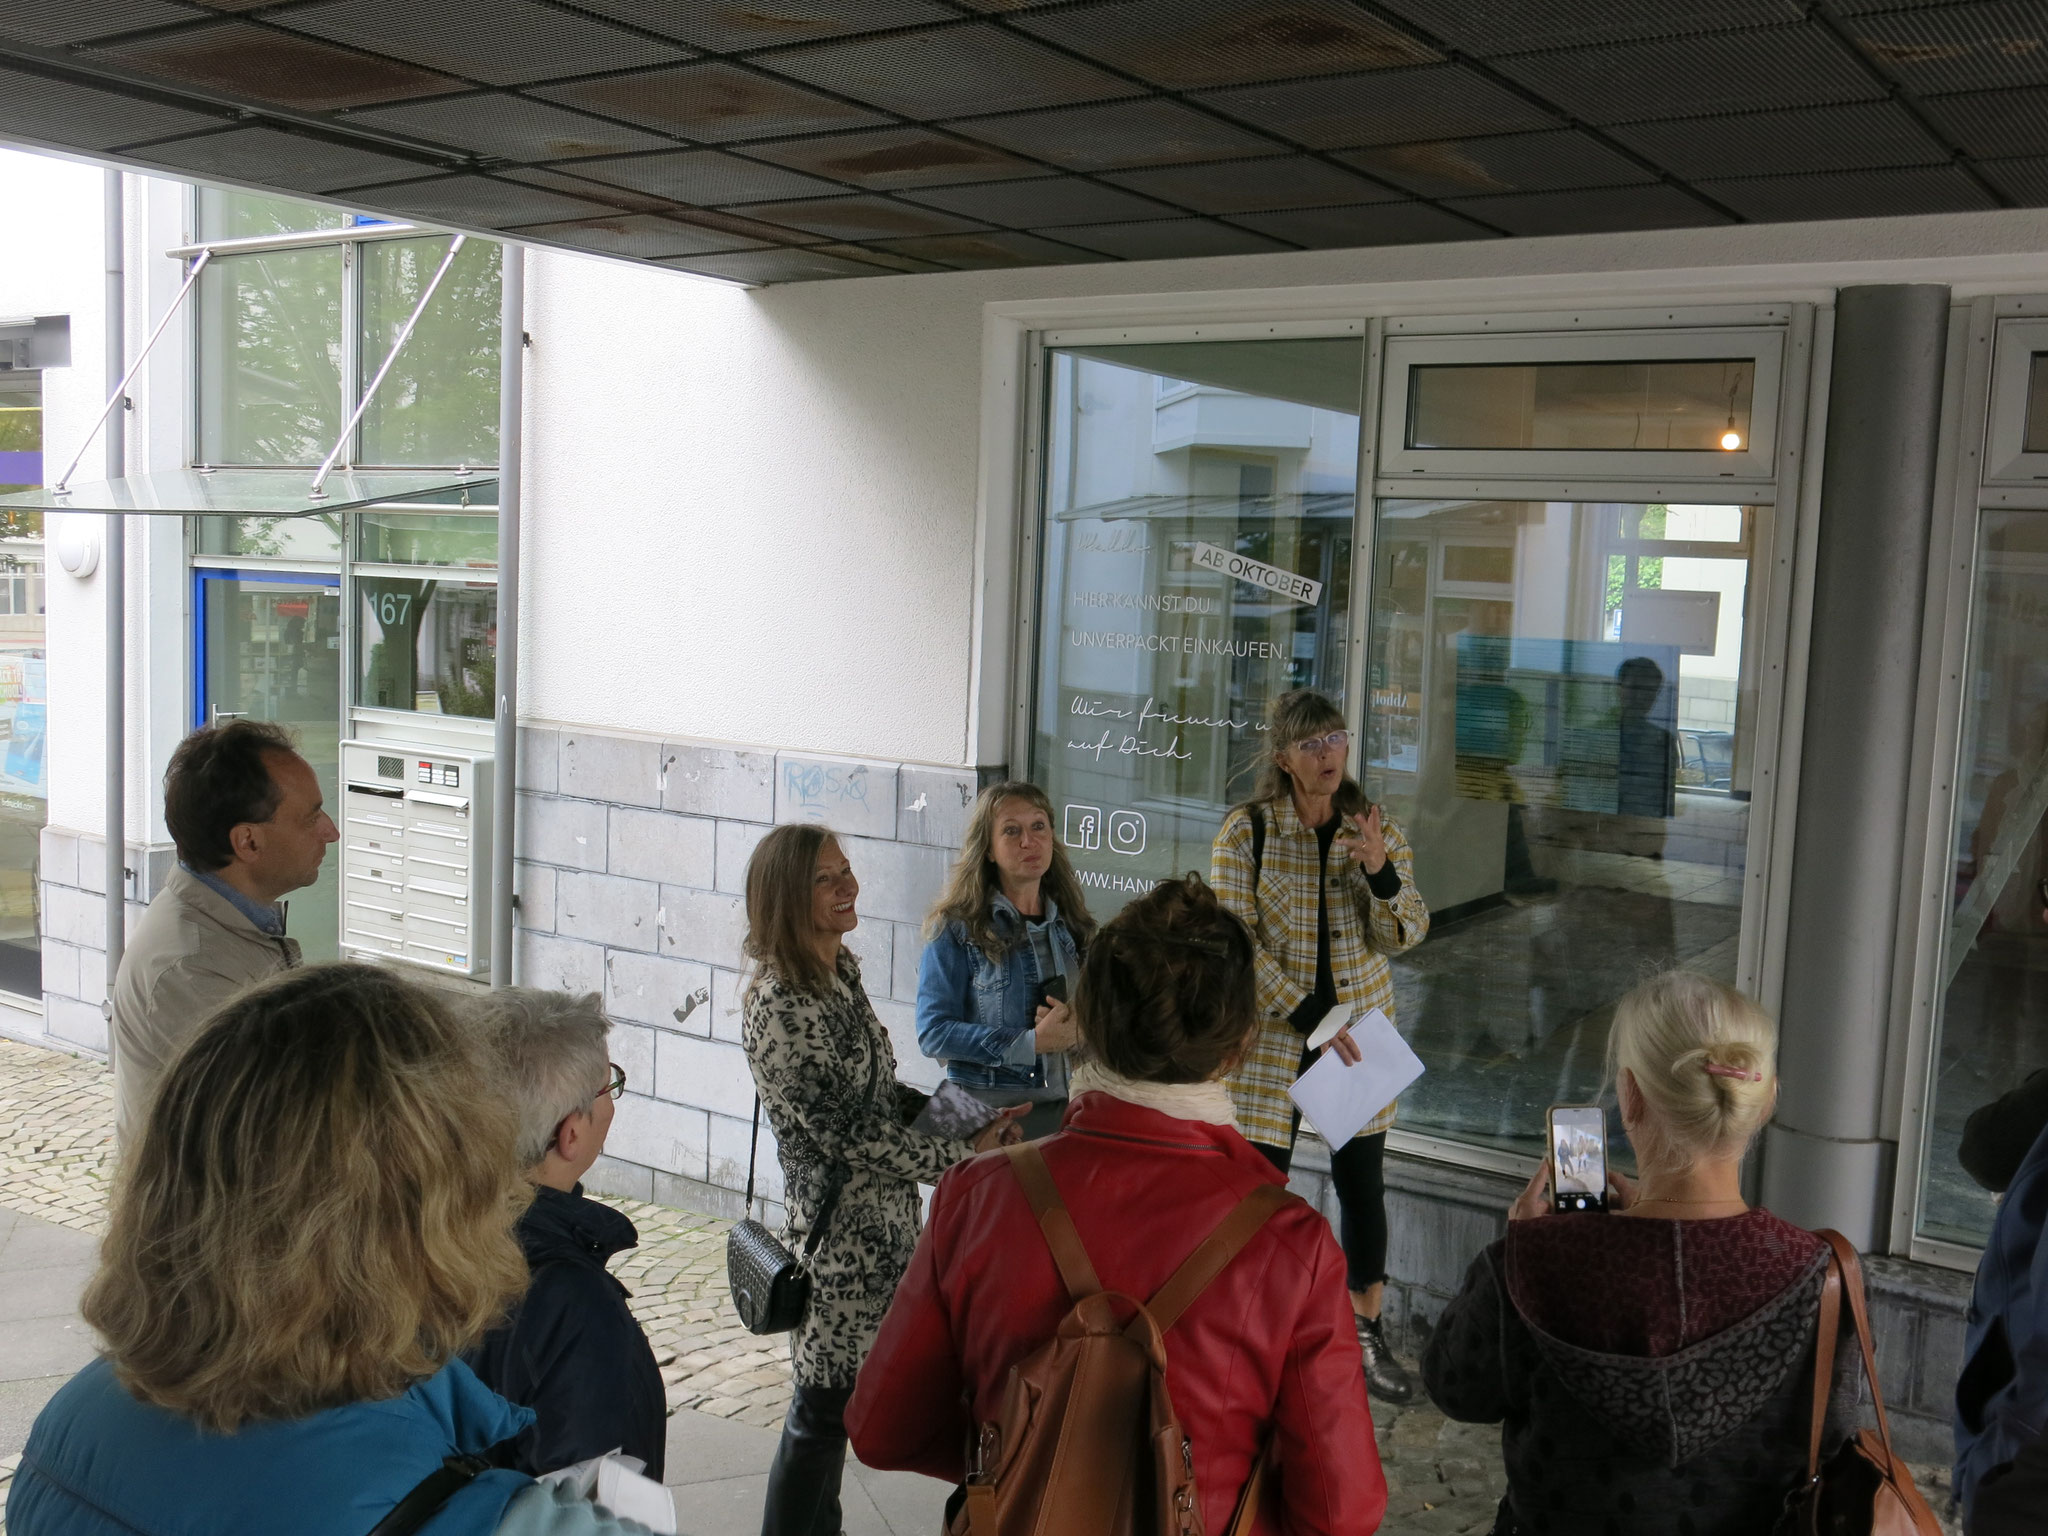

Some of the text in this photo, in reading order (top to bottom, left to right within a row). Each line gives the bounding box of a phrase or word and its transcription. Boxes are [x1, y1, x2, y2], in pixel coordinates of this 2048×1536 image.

[1200, 548, 1314, 600] AB OKTOBER
[369, 591, 412, 625] 167
[1073, 591, 1211, 614] HIER KANNST DU
[1072, 630, 1288, 660] UNVERPACKT EINKAUFEN.
[1071, 695, 1133, 718] Wir
[1137, 697, 1249, 732] freuen
[1067, 729, 1192, 762] auf Dich.
